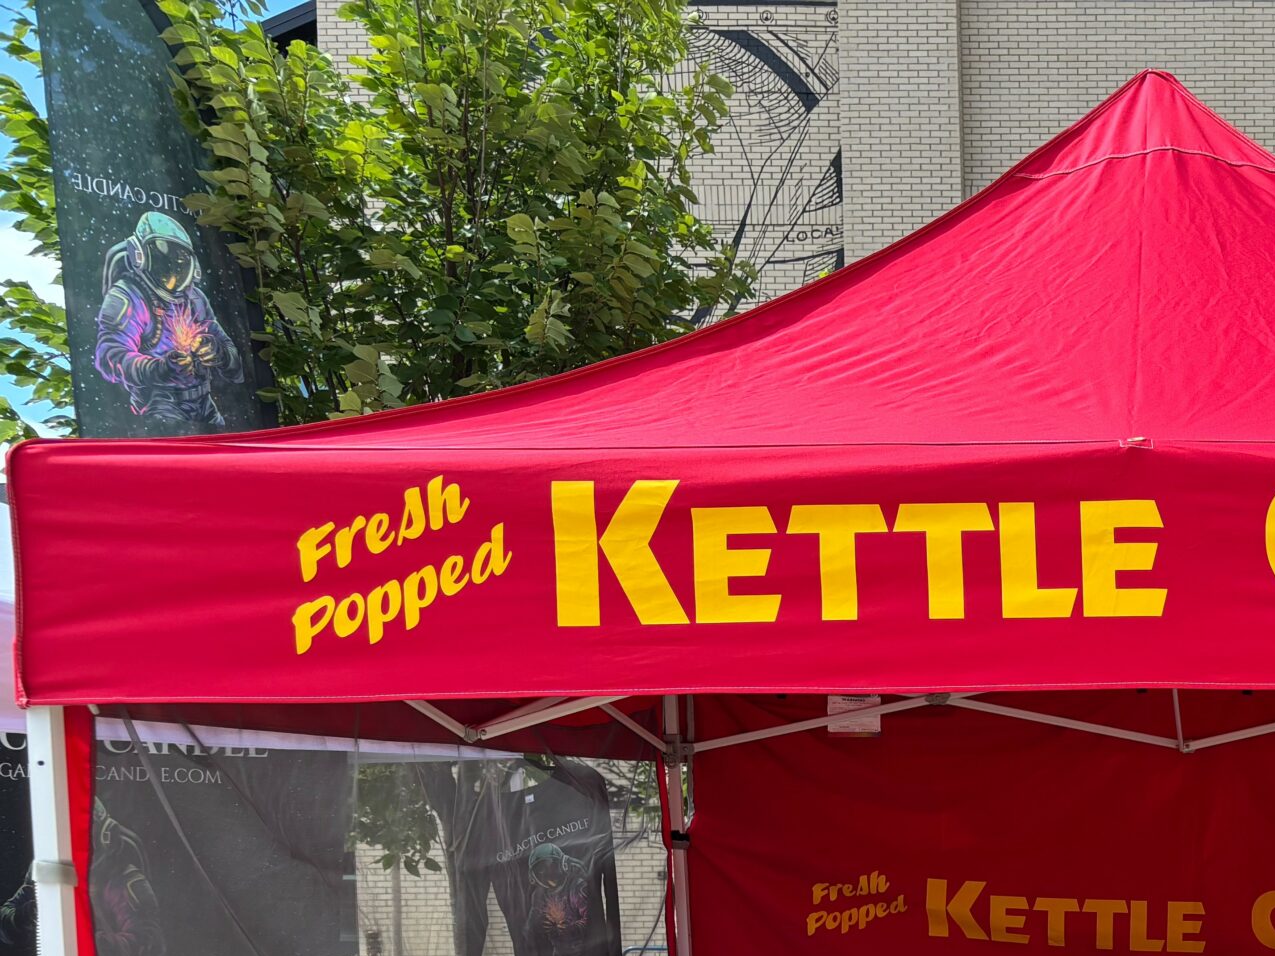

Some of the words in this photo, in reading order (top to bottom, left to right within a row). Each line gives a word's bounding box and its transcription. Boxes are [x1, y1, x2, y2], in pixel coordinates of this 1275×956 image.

[296, 476, 471, 583] Fresh
[551, 480, 1168, 627] KETTLE
[292, 524, 513, 655] Popped
[806, 894, 908, 937] Popped
[812, 870, 891, 905] Fresh
[926, 877, 1206, 953] KETTLE
